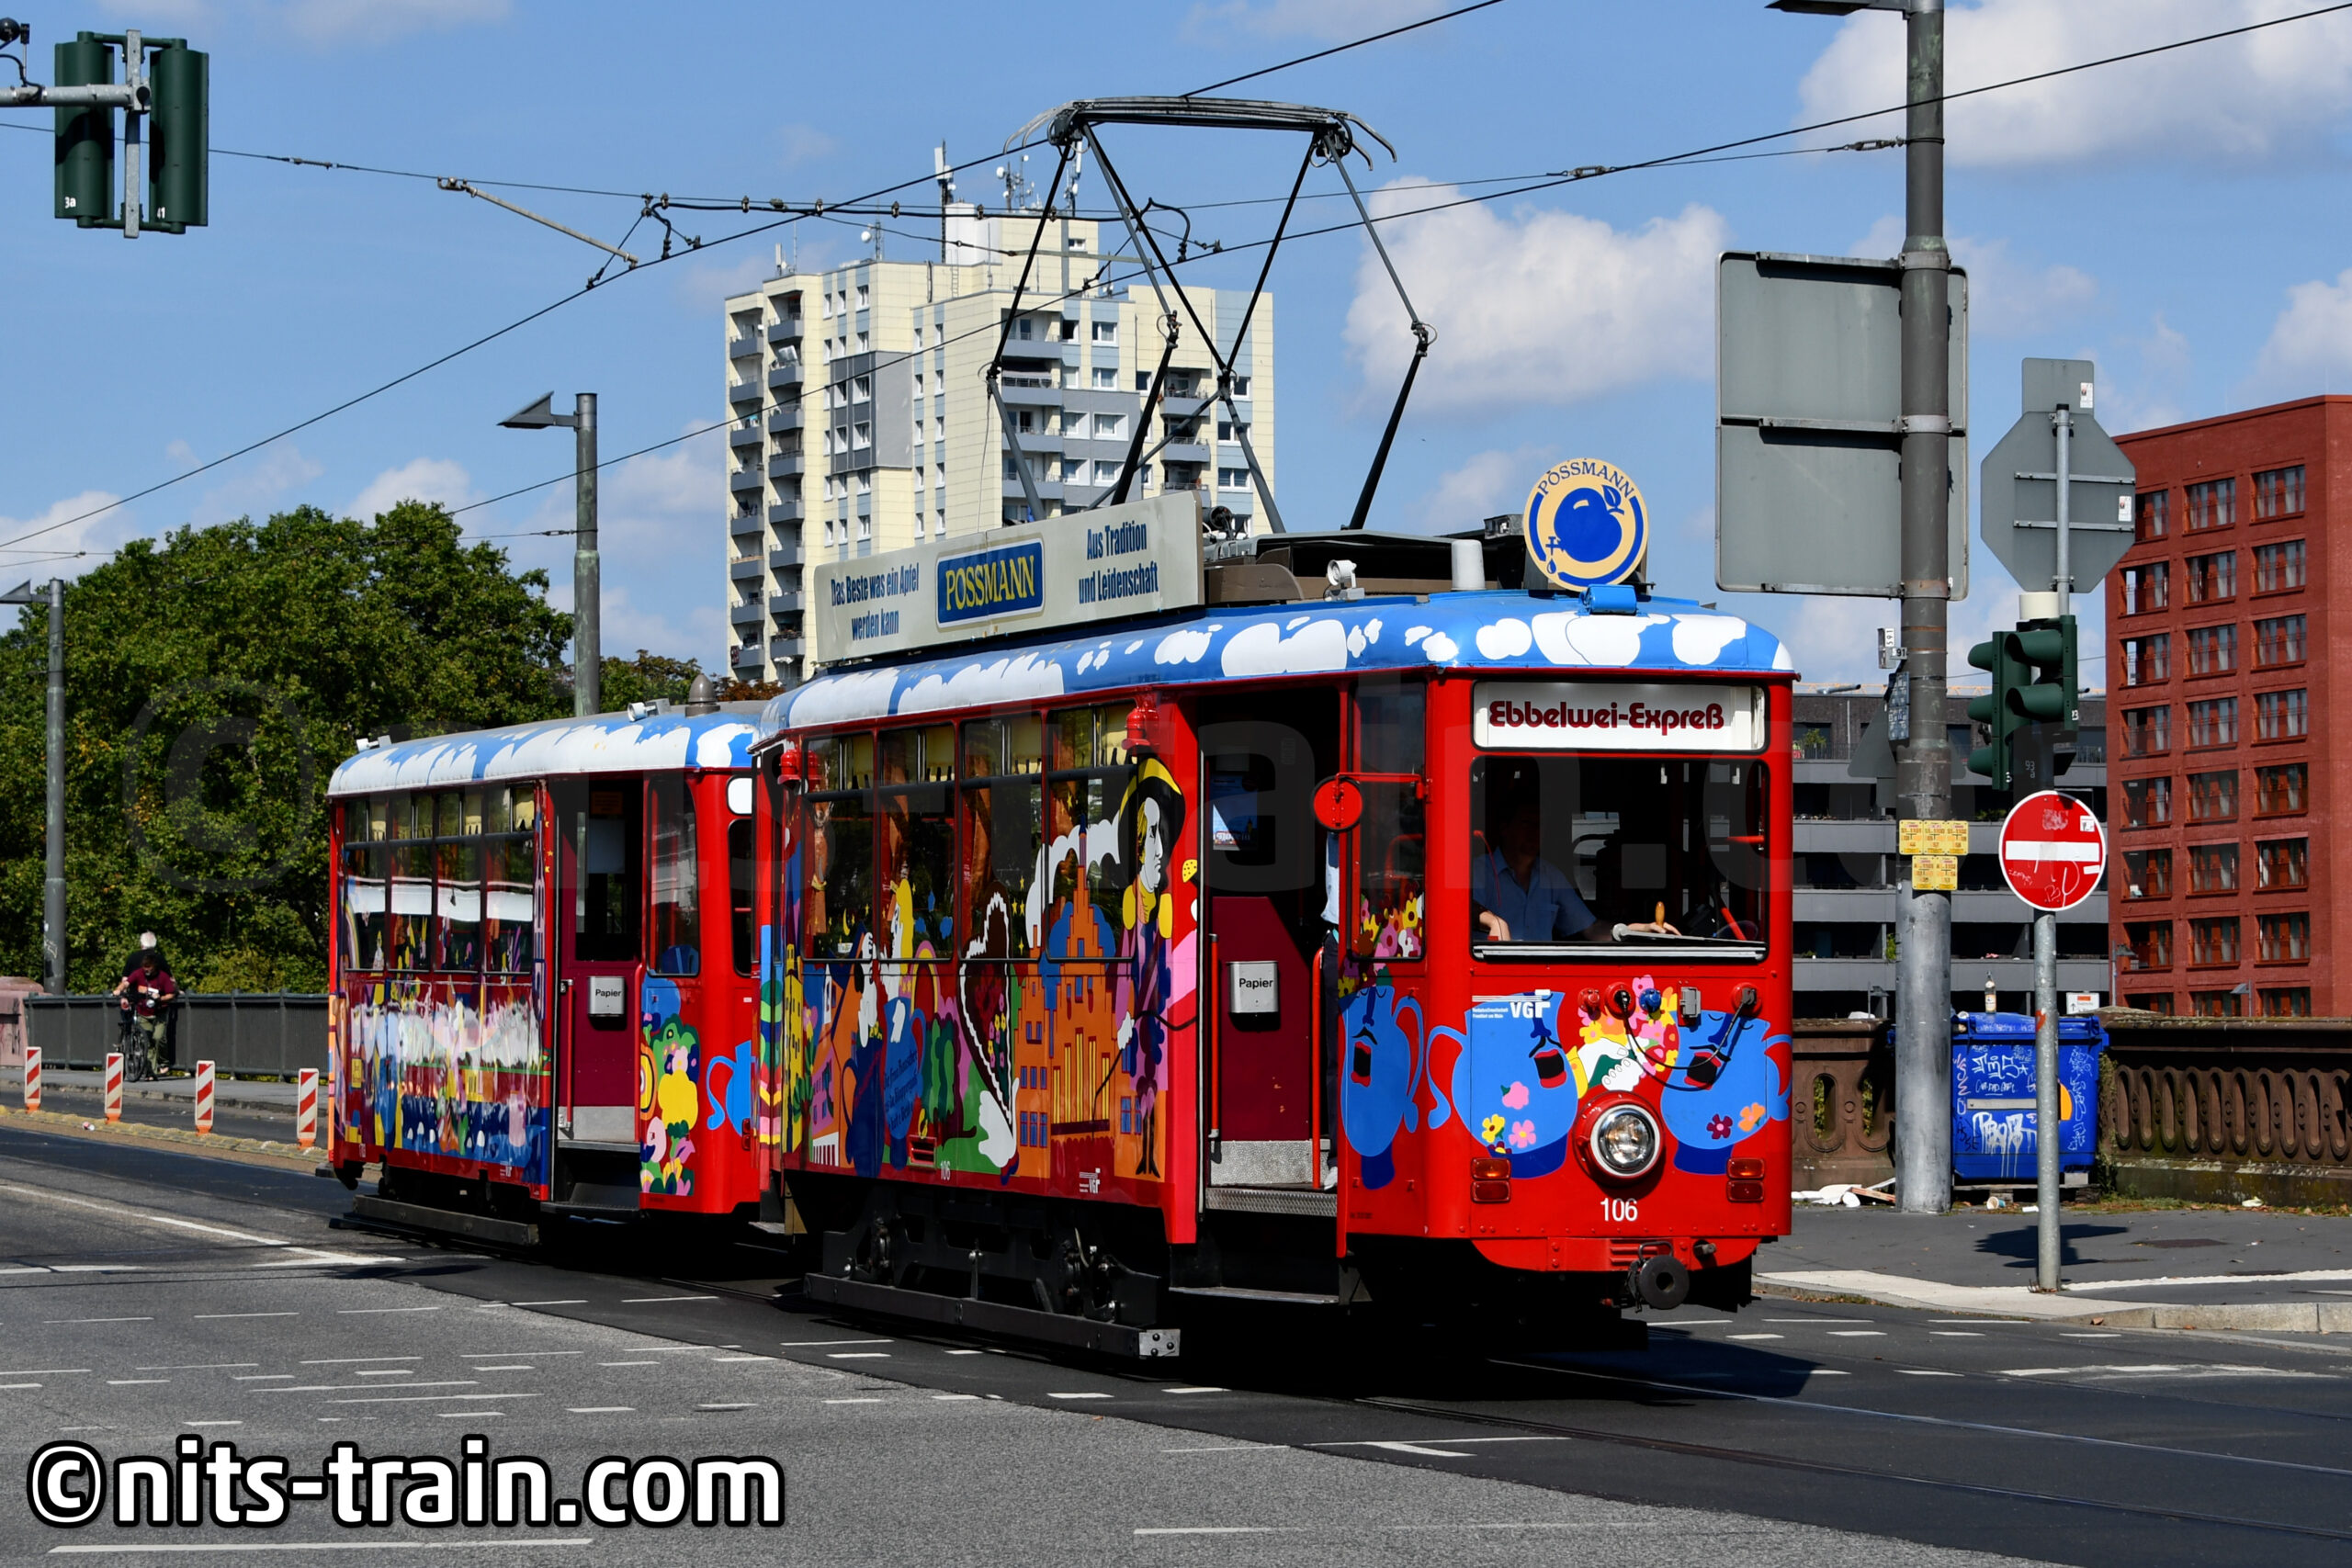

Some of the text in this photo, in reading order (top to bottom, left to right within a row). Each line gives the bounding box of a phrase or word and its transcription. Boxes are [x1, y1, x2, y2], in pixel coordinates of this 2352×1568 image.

[1537, 460, 1635, 499] POSSMANN
[1087, 520, 1147, 560] Aus Tradition
[831, 562, 920, 606] Das Beste was ein Apfel
[945, 555, 1035, 611] POSSMANN
[1079, 560, 1159, 604] und Leidenschaft
[851, 608, 899, 641] werden kann
[1489, 701, 1724, 736] Ebbelwei-Expreß
[594, 988, 622, 998] Papier
[1238, 977, 1274, 990] Papier
[941, 1160, 951, 1181] 106
[1600, 1198, 1639, 1223] 106
